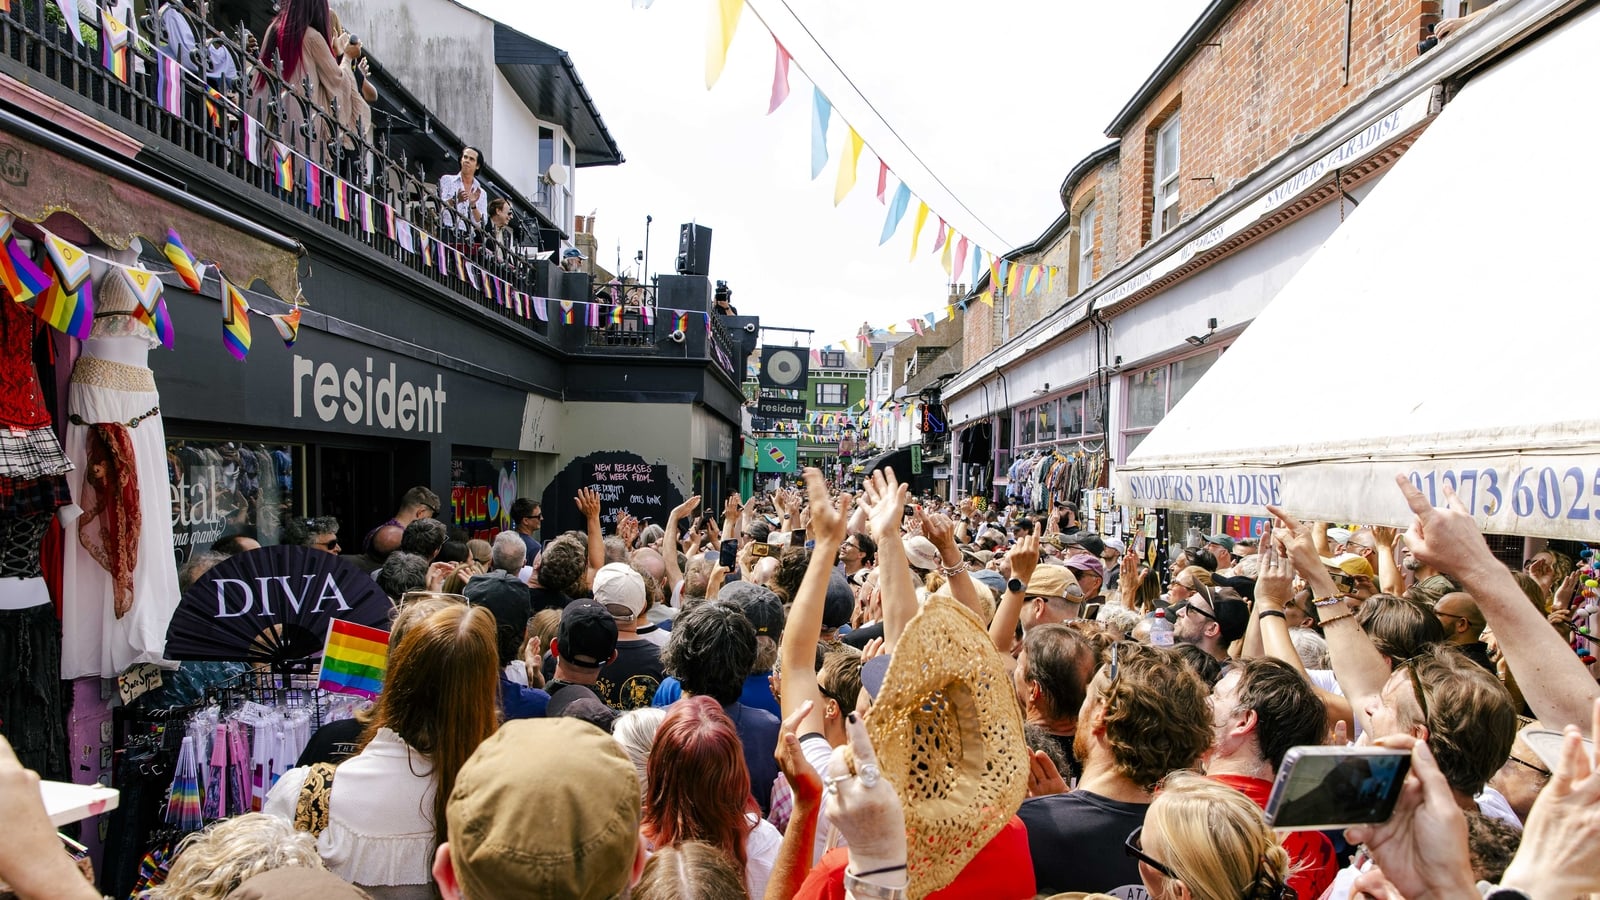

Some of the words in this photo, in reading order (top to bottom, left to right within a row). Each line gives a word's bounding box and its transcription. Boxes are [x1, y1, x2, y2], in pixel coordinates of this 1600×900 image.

[1265, 161, 1325, 208] SNOOPERS
[1327, 107, 1404, 167] PARADISE
[293, 354, 447, 433] resident
[761, 403, 803, 413] resident
[592, 472, 607, 481] THIS
[610, 473, 628, 481] WEEK
[595, 464, 611, 472] NEW
[614, 463, 652, 473] RELEASES
[170, 465, 221, 526] etal
[599, 493, 619, 502] OLUMN
[630, 494, 644, 504] OPUS
[1198, 473, 1282, 506] PARADISE
[451, 486, 487, 524] THE
[211, 572, 354, 618] DIVA
[337, 744, 356, 752] THE
